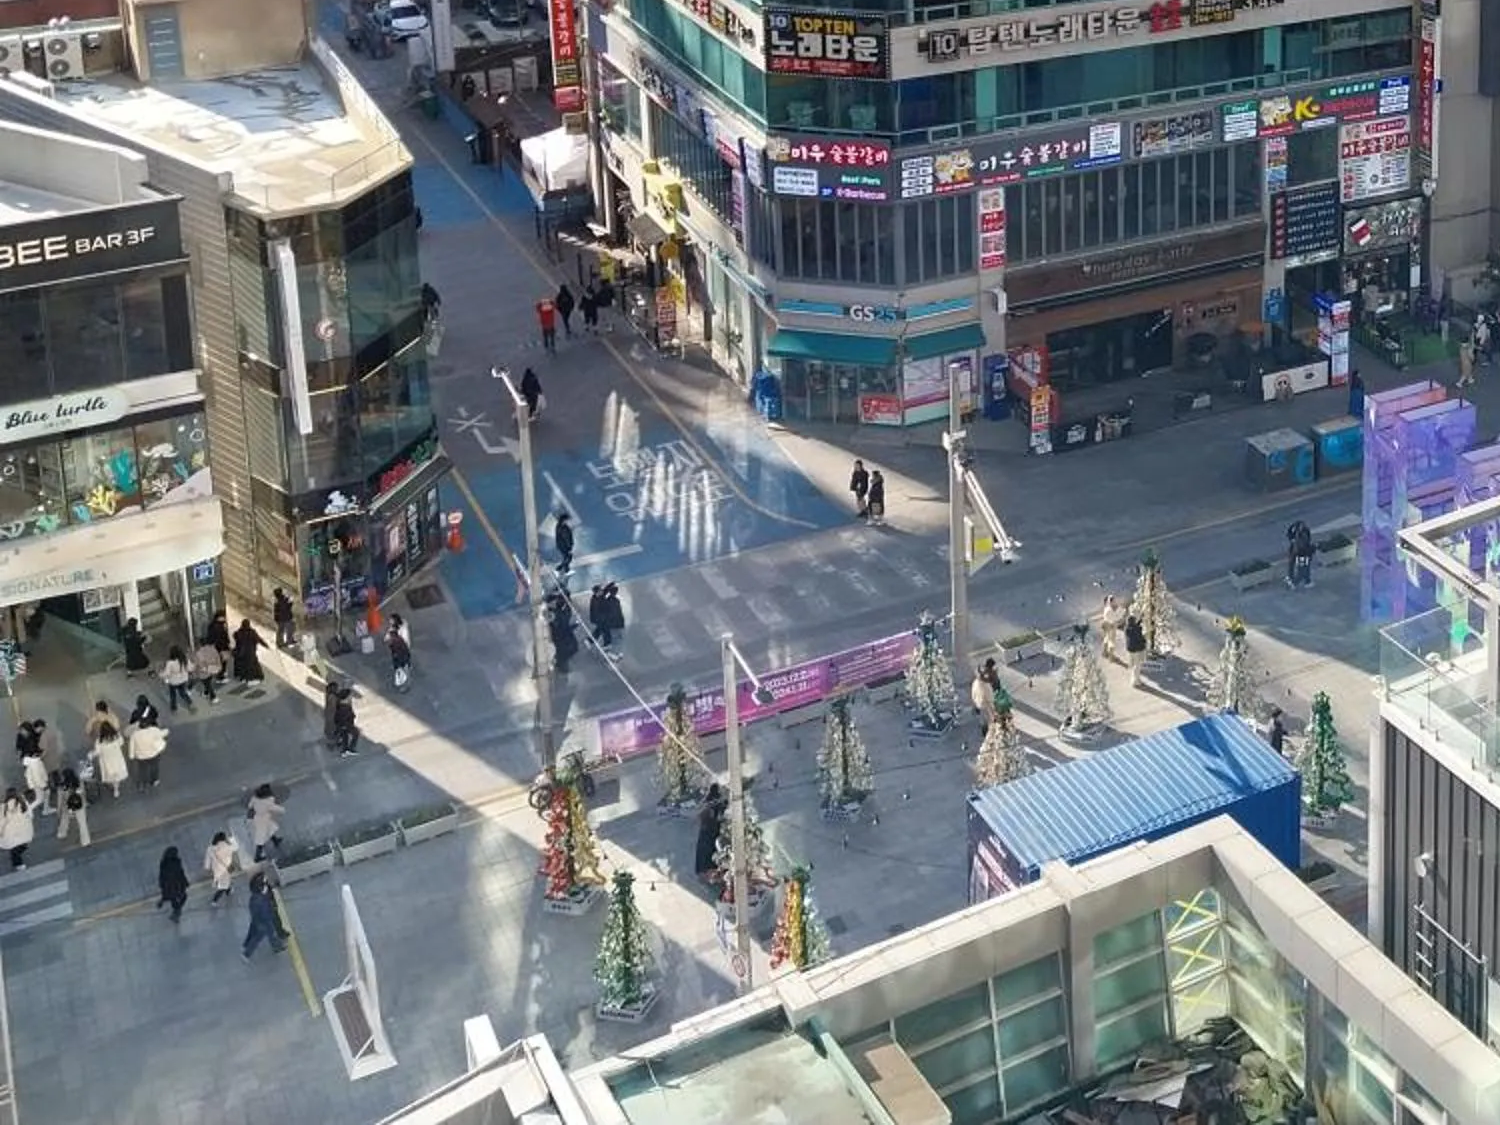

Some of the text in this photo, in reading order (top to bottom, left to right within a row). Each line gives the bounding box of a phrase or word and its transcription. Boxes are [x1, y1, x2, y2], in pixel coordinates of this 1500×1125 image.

[771, 31, 879, 63] 노래타운
[75, 232, 123, 254] BAR
[127, 226, 155, 247] 3F
[850, 304, 897, 321] GS25
[5, 396, 107, 430] Blue turtle
